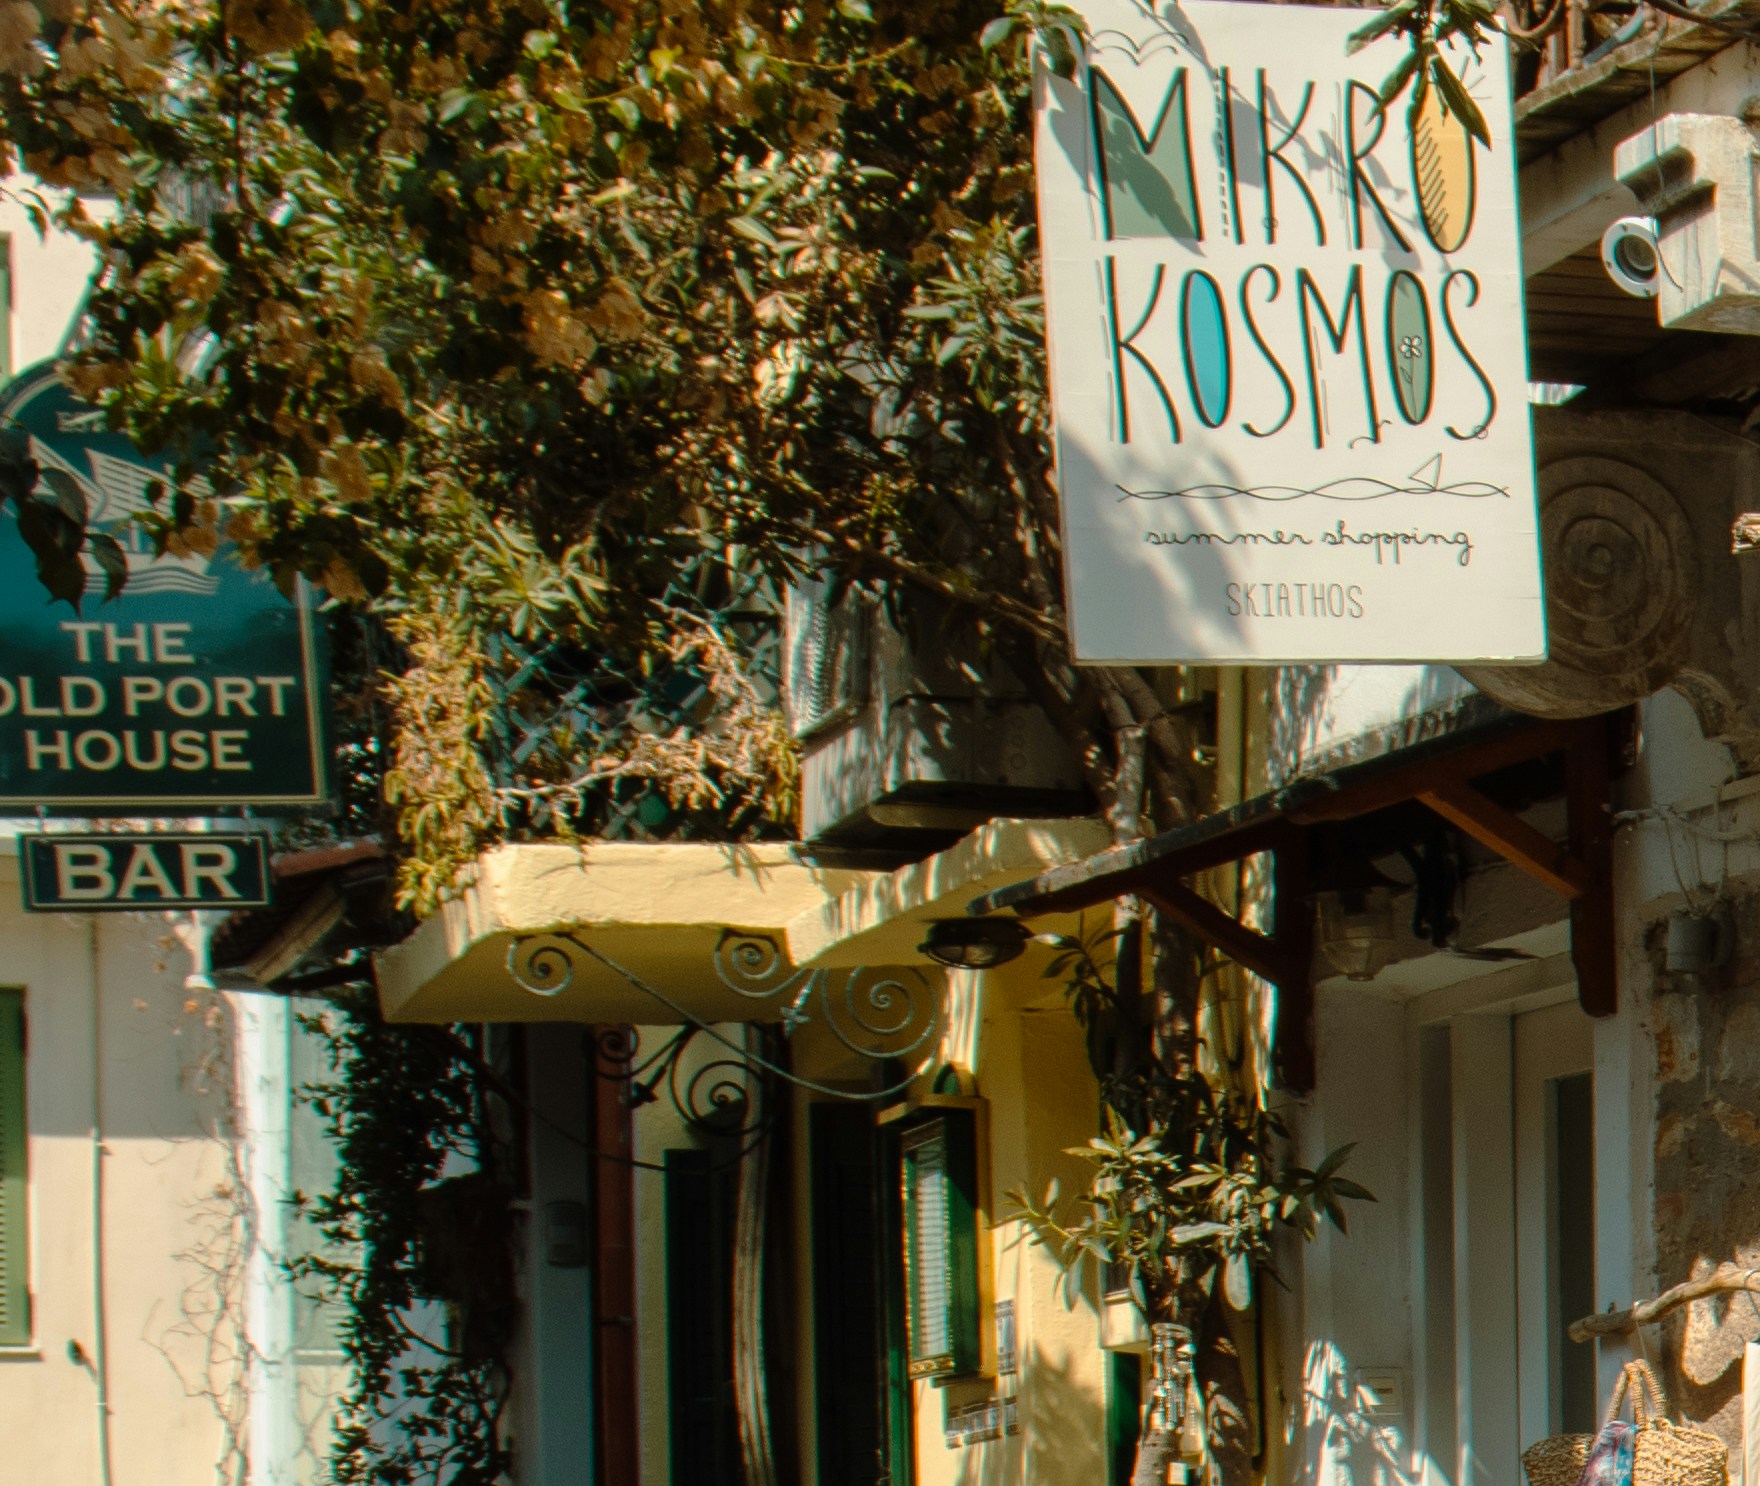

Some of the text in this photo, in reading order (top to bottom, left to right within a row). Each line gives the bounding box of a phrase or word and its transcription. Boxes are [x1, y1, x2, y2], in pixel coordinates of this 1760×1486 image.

[1088, 66, 1478, 254] MIKRO
[1104, 256, 1498, 450] KOSMOS
[1144, 520, 1475, 567] summer shopping
[1226, 582, 1366, 619] SKIATHOS
[59, 621, 195, 664] THE
[121, 675, 297, 718] PORT
[24, 729, 253, 771] HOUSE
[53, 842, 243, 901] BAR
